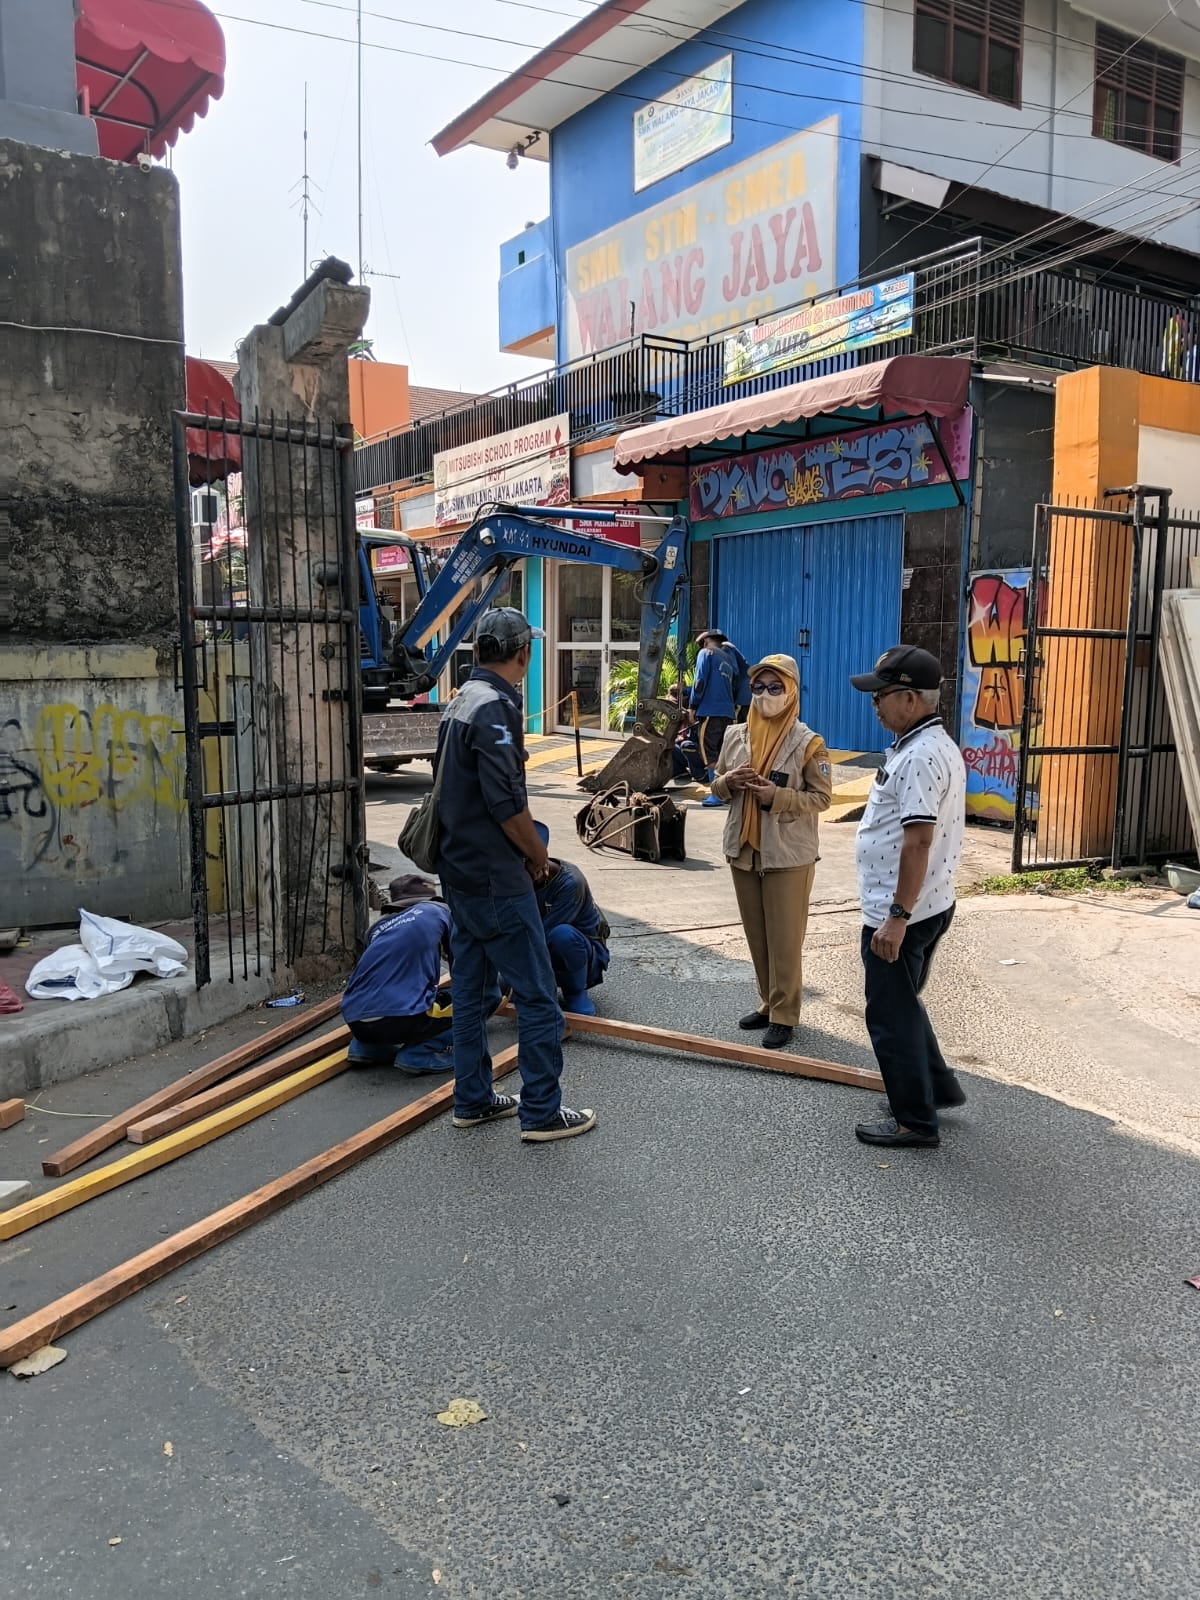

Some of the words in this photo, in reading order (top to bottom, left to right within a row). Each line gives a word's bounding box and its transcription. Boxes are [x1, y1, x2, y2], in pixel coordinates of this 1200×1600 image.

[577, 239, 621, 293] SMK
[644, 202, 697, 261] STM
[724, 151, 808, 227] SMEA
[575, 247, 706, 355] WALANG
[722, 200, 823, 302] JAYA
[823, 289, 875, 321] PAINTING
[774, 331, 811, 356] AUTO
[449, 452, 484, 473] MITSUBISHI
[484, 442, 513, 464] SCHOOL
[514, 429, 552, 454] PROGRAM
[700, 453, 797, 516] DYNO
[804, 419, 935, 494] TEST
[453, 496, 465, 512] SMK
[466, 489, 493, 510] WALANG
[493, 483, 512, 503] JAYA
[511, 476, 543, 500] JAKARTA
[532, 537, 591, 557] HYUNDAI
